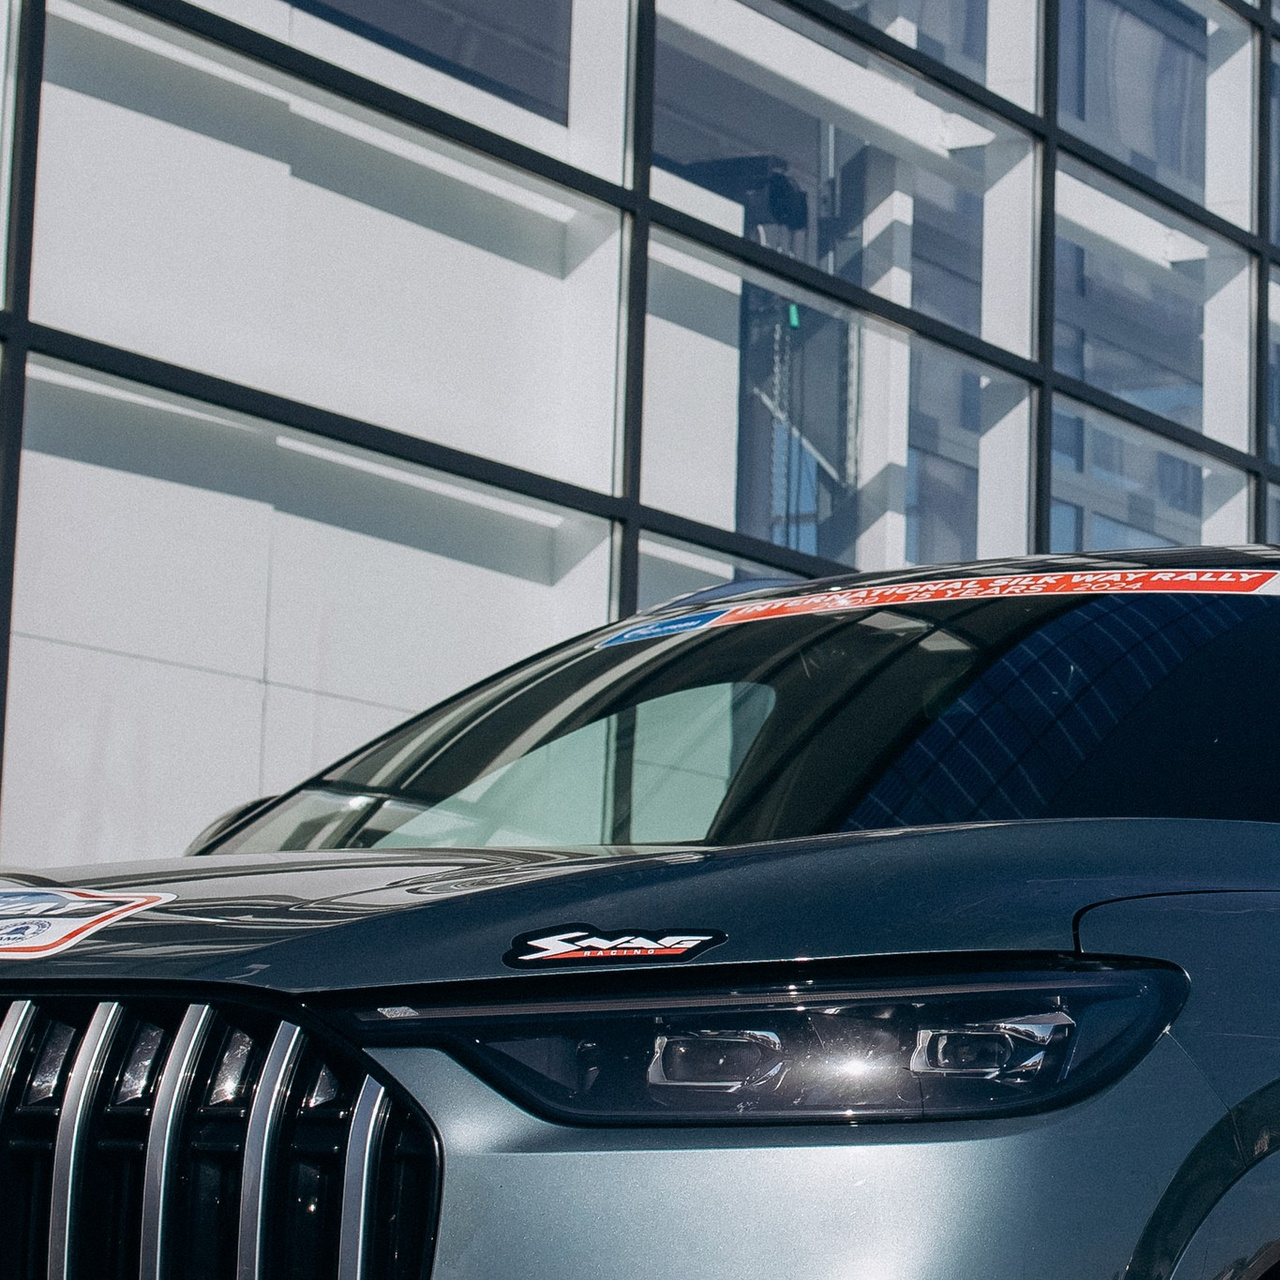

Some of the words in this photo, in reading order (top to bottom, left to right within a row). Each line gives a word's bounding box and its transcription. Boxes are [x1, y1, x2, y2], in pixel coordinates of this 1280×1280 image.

[736, 581, 982, 615] INTERNATIONAL
[988, 575, 1060, 588] SILK
[1071, 572, 1148, 583] WAY
[1150, 572, 1263, 582] RALLY
[905, 591, 934, 602] 15
[945, 585, 1047, 598] YEARS
[1072, 581, 1141, 591] 2024
[518, 931, 714, 960] SNAG
